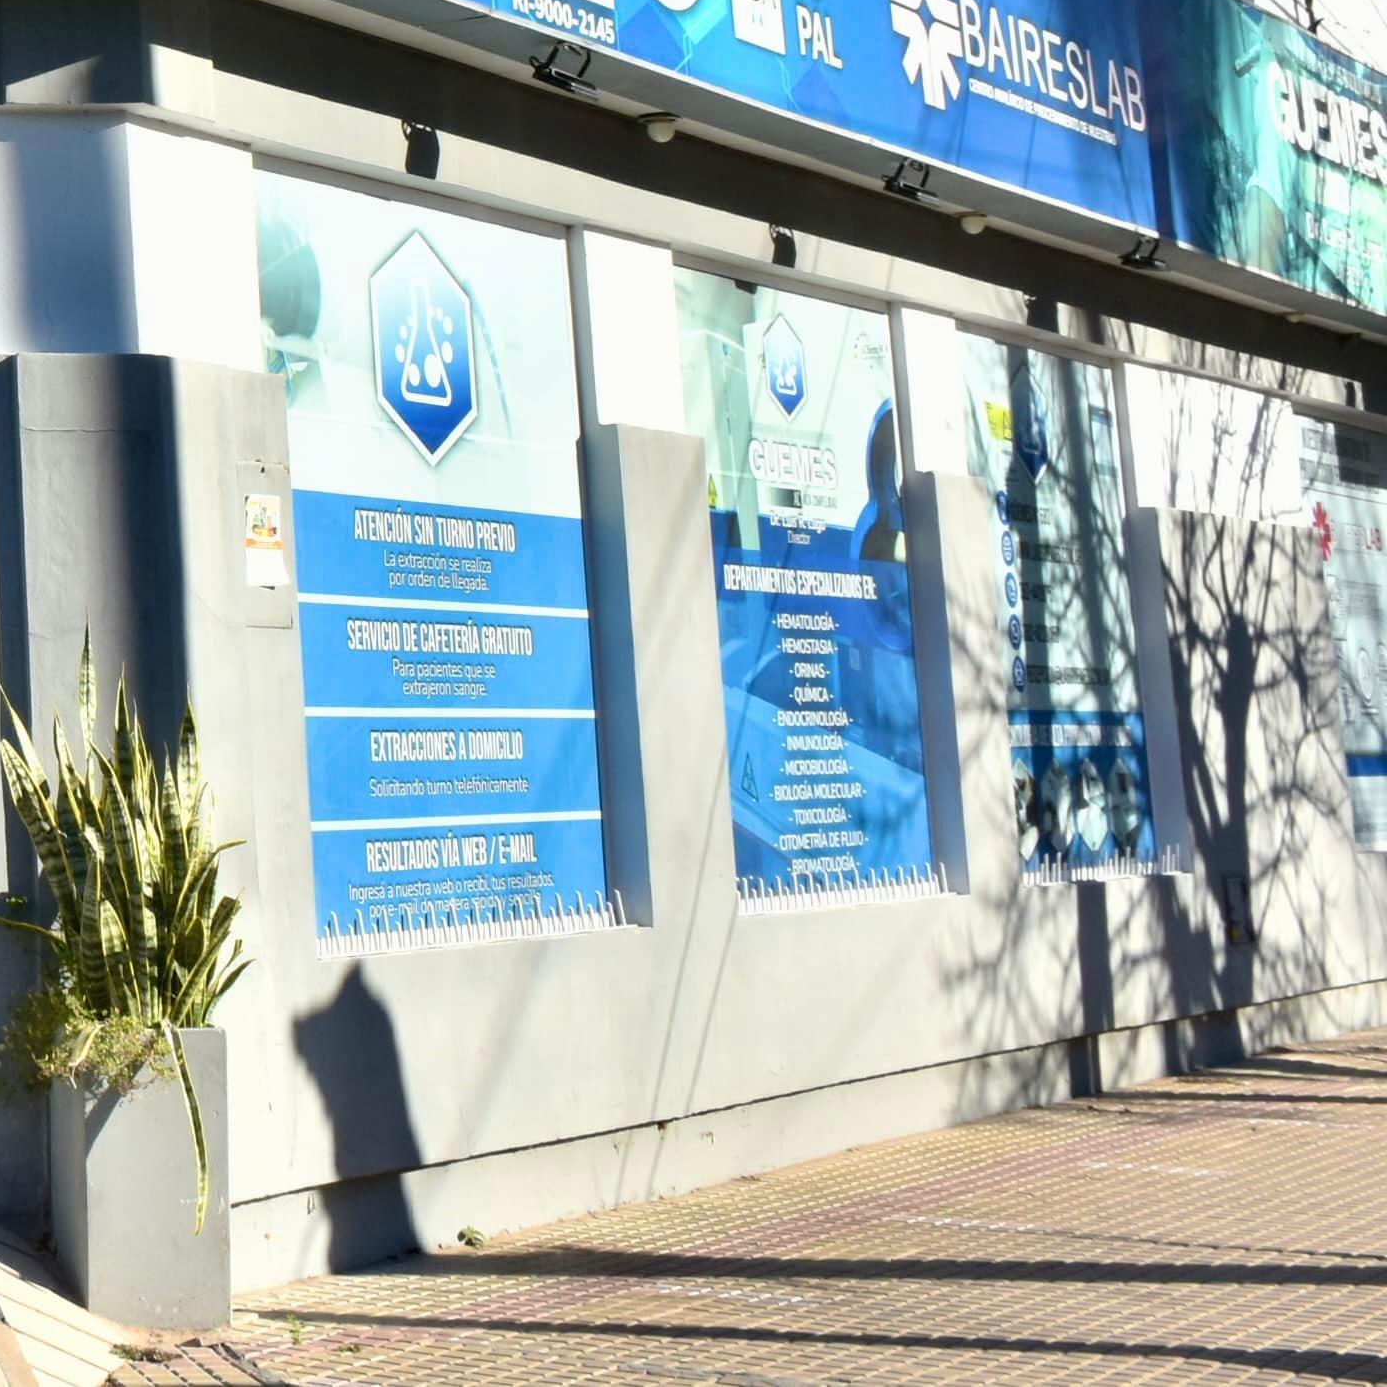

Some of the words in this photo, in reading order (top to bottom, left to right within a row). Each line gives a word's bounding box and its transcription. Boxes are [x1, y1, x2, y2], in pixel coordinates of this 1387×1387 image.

[796, 4, 843, 70] PAL
[354, 506, 412, 544] ATENCIÓN
[414, 514, 434, 545] SIN
[436, 516, 475, 549] TURNO
[477, 521, 516, 552] PREVIO
[384, 549, 395, 566] La
[398, 552, 447, 570] extracción
[449, 558, 460, 572] se
[462, 556, 492, 573] realiza
[723, 564, 797, 594] DEPARTAMENTOS
[797, 569, 862, 599] ESPECIALIZADOS
[777, 611, 835, 630] HEMATOLOGÍA
[347, 618, 400, 651] SERVICIO
[402, 620, 418, 652] DE
[420, 618, 478, 654] CAFETERÍA
[482, 625, 533, 656] GRATUITO
[782, 637, 834, 654] HEMOSTASIA
[794, 662, 825, 678] ORINAS
[794, 682, 829, 705] QUÍMICA
[370, 730, 456, 762] EXTRACCIONES
[459, 730, 467, 760] A
[469, 729, 523, 760] DOMICILIO
[369, 778, 425, 797] Solicitando
[427, 778, 452, 795] turno
[455, 775, 528, 794] telefónicamente
[774, 780, 813, 801] BIOLOGÍA
[814, 782, 862, 800] MOLECULAR
[366, 837, 439, 873] RESULTADOS
[441, 830, 460, 868] VÍA
[461, 835, 487, 866] WEB
[499, 833, 537, 864] E-MAIL
